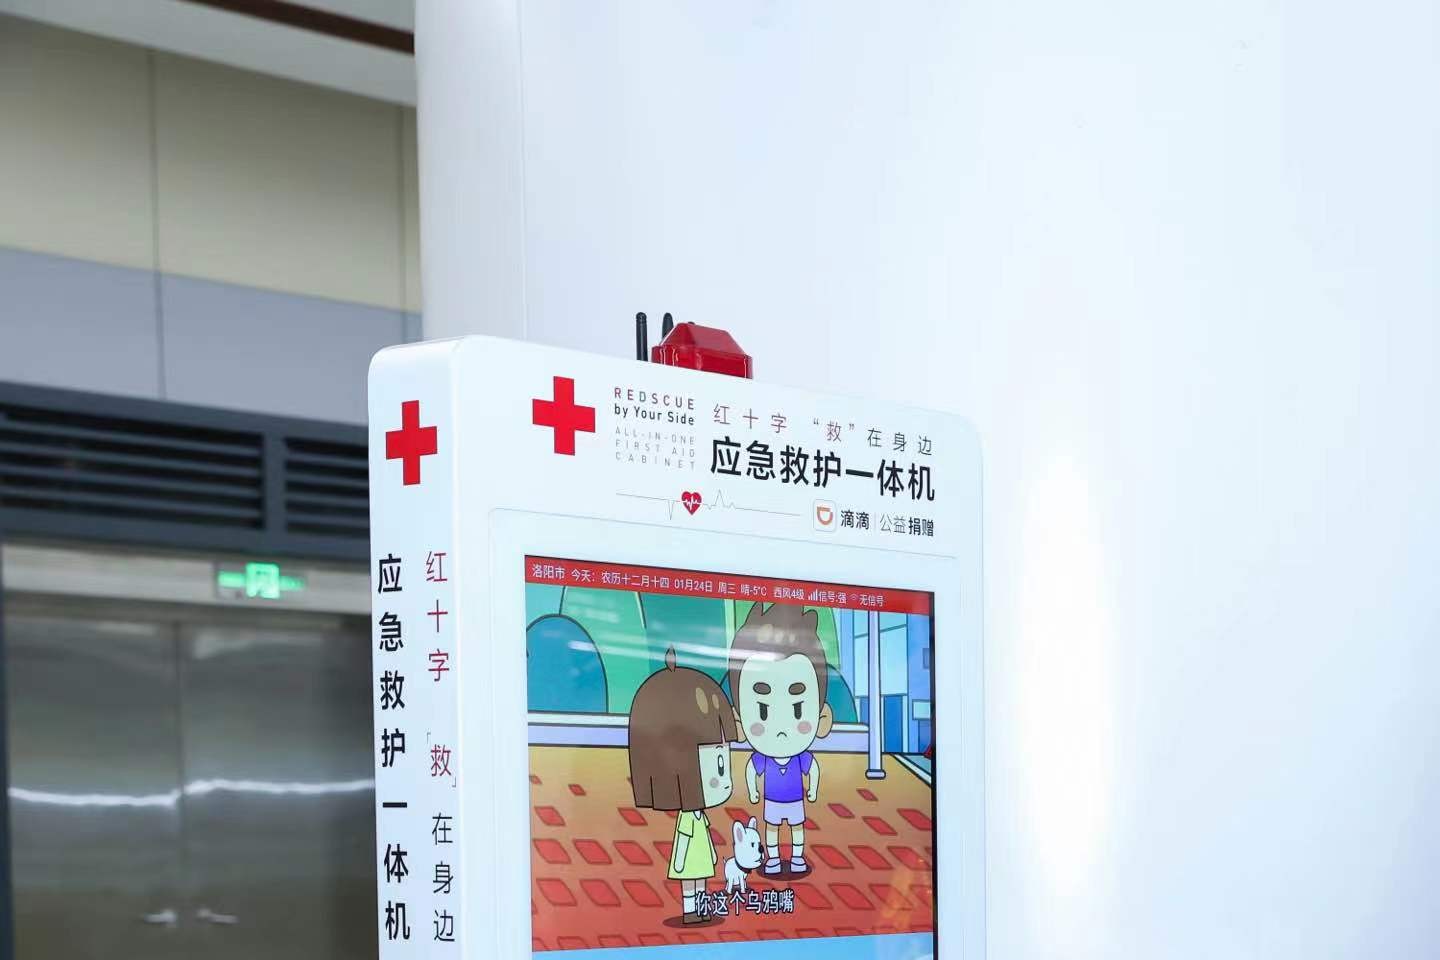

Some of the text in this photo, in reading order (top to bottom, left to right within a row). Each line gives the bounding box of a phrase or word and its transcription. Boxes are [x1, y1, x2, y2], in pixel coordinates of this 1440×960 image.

[614, 387, 694, 410] REDSCUE
[614, 403, 695, 426] by Your Side
[615, 425, 694, 446] ALL-IN-ONE
[616, 439, 660, 452] FIRST
[616, 451, 695, 470] CABINET
[710, 435, 935, 502] 应急救护一体机
[840, 509, 870, 530] 滴滴
[532, 564, 566, 580] 洛阳市
[601, 571, 670, 589] 农历十二月十四
[674, 579, 713, 593] 01月24日
[718, 581, 737, 595] 周三
[859, 594, 885, 608] 无信号
[377, 553, 411, 941] 应急救护一体机
[695, 890, 795, 917] 你这个乌鸦嘴
